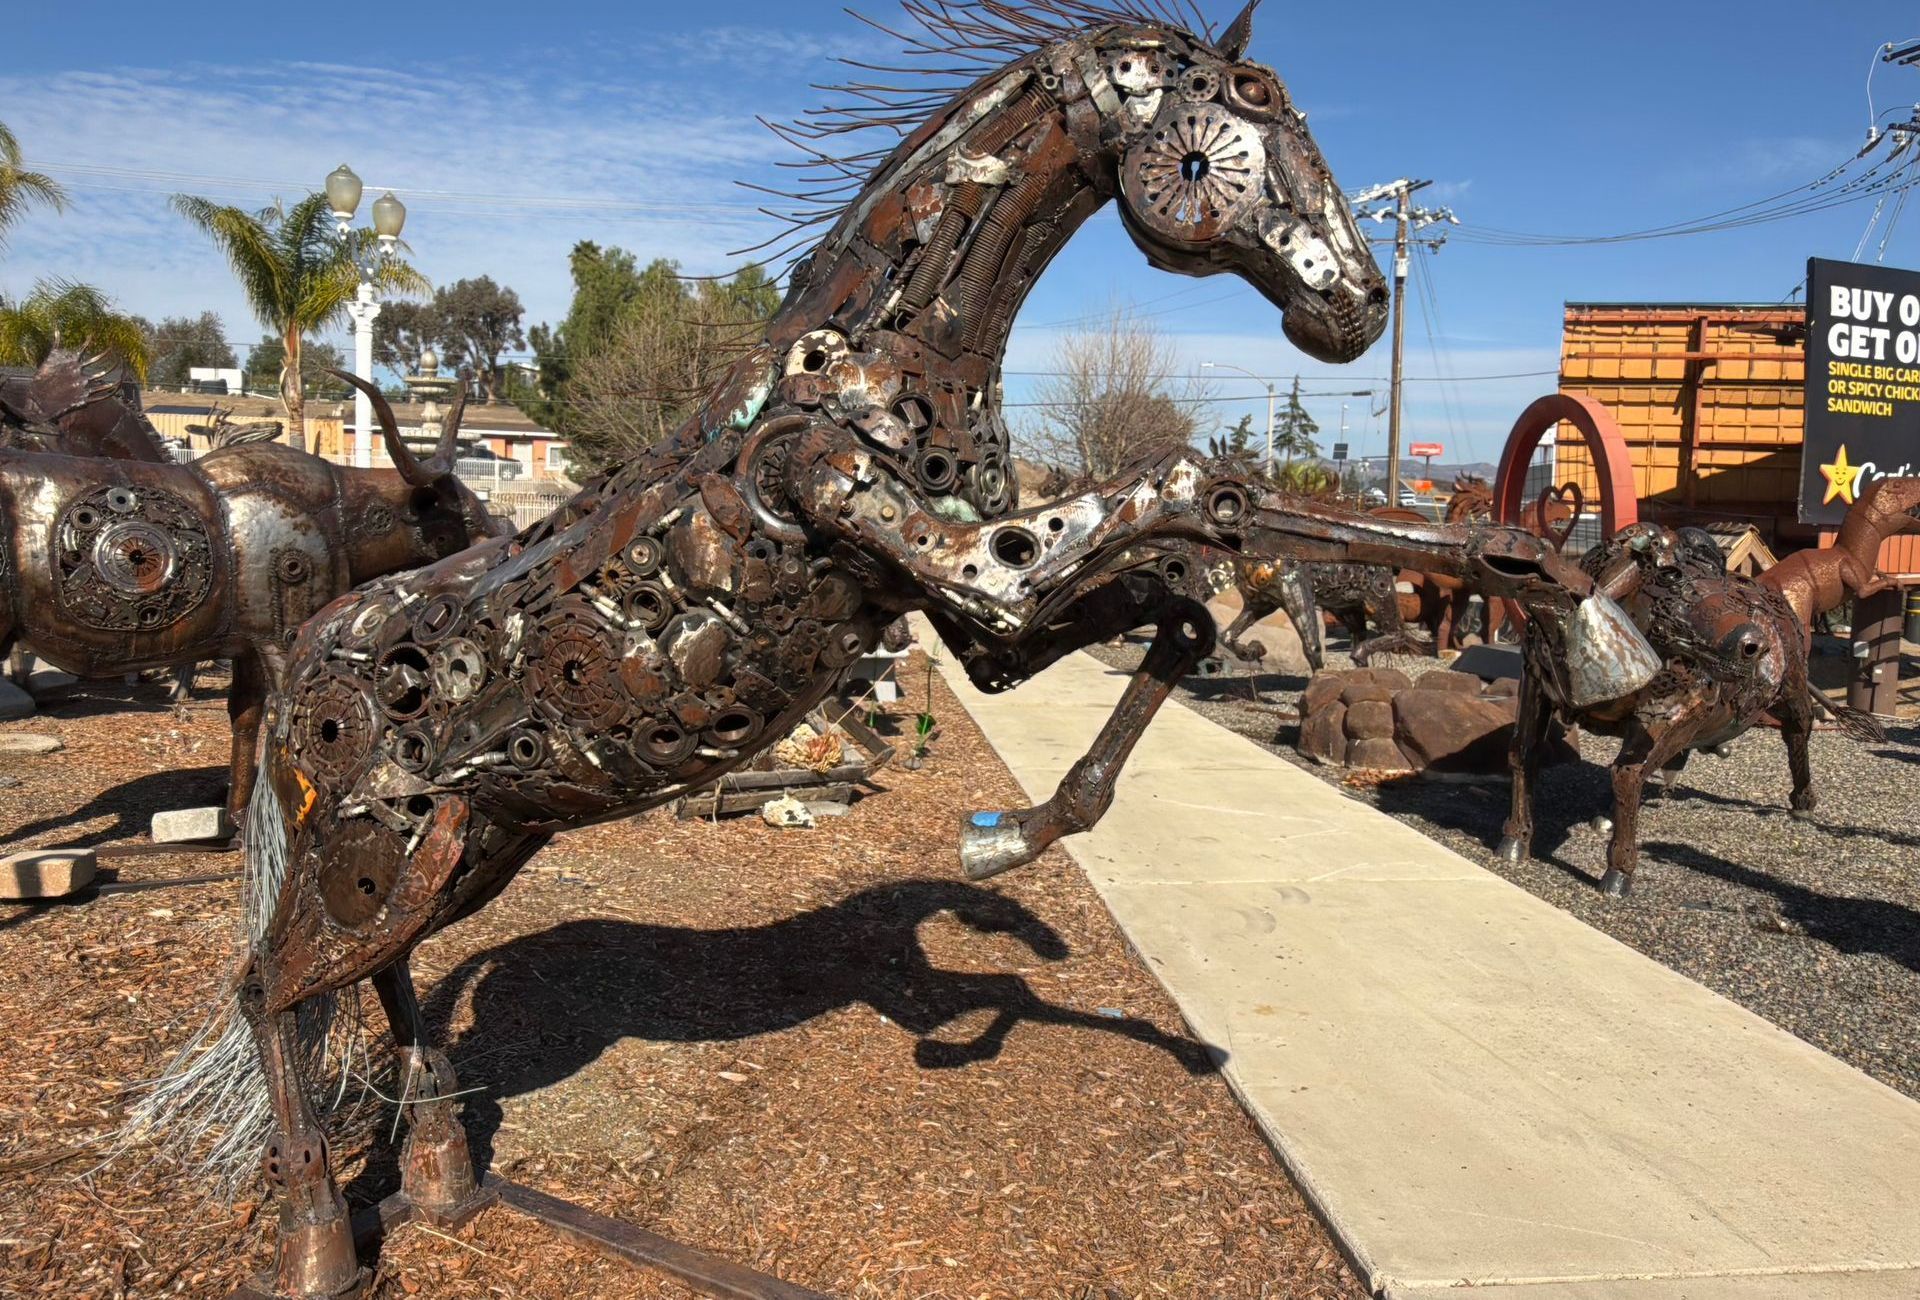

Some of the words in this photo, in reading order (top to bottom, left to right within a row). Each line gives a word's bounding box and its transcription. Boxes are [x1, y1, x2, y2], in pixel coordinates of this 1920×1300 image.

[1830, 285, 1894, 323] BUY
[1899, 294, 1920, 327] O
[1827, 322, 1890, 360] GET
[1895, 330, 1920, 364] O
[1828, 361, 1872, 379] SINGLE
[1874, 366, 1894, 381] BIG
[1896, 368, 1920, 383] CAR
[1828, 379, 1846, 395] OR
[1848, 381, 1883, 398] SPICY
[1885, 385, 1920, 401] CHICK
[1827, 397, 1893, 416] SANDWICH
